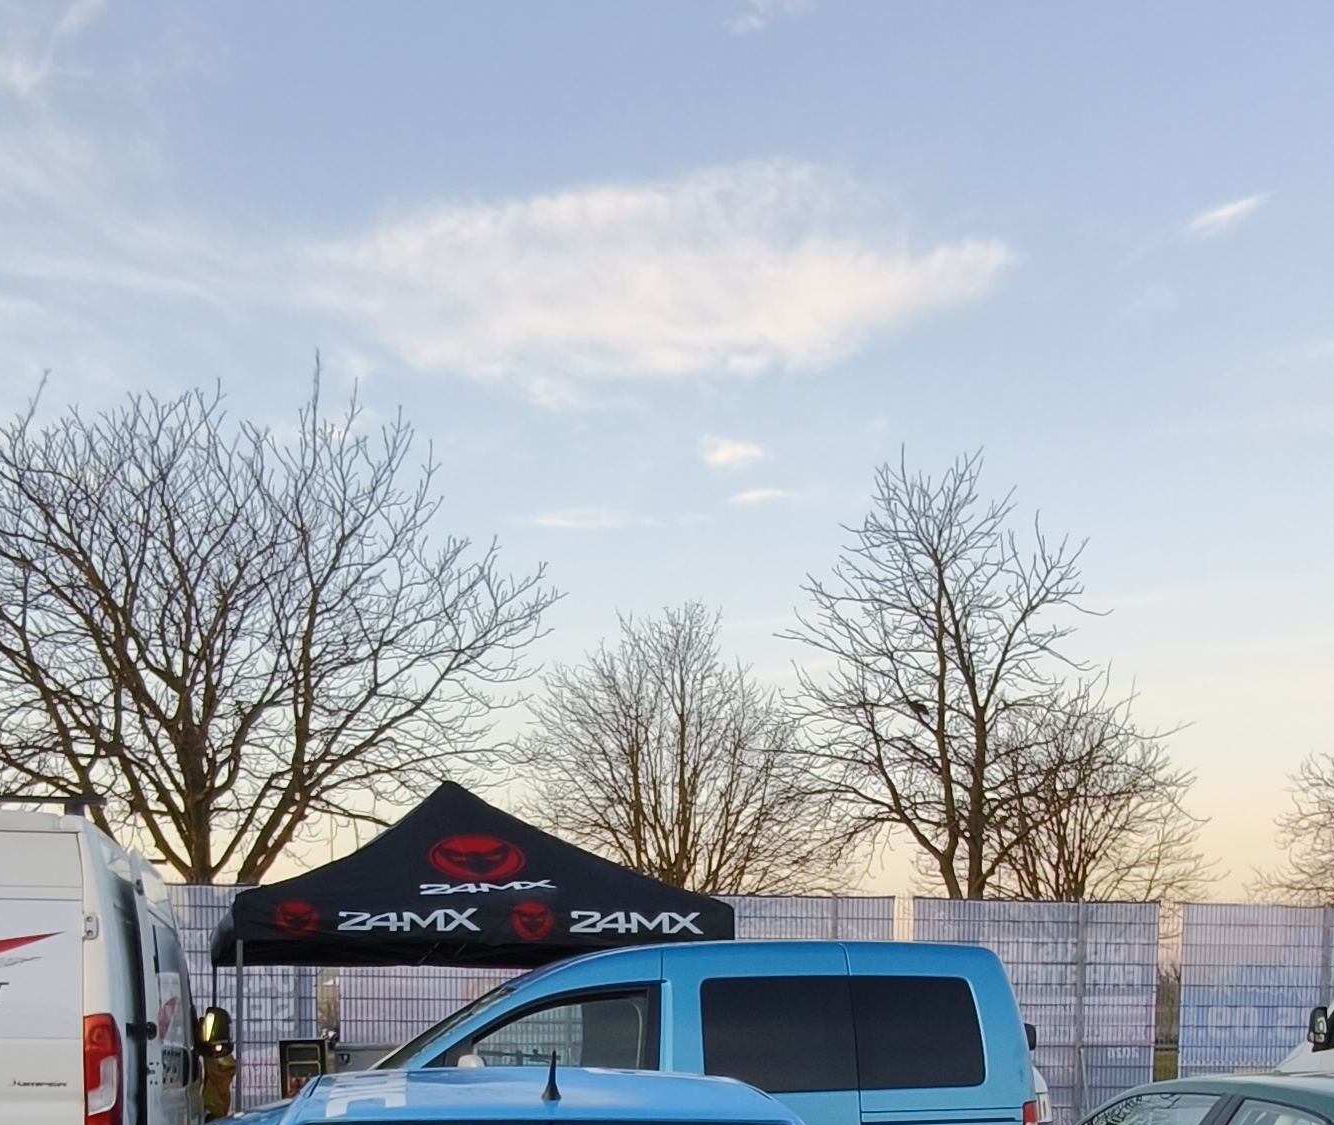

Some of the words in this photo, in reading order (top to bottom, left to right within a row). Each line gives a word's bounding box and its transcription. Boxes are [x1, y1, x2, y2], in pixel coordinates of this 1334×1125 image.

[419, 879, 557, 896] 24MX
[338, 908, 481, 932] 24MX
[570, 910, 704, 935] 24MX
